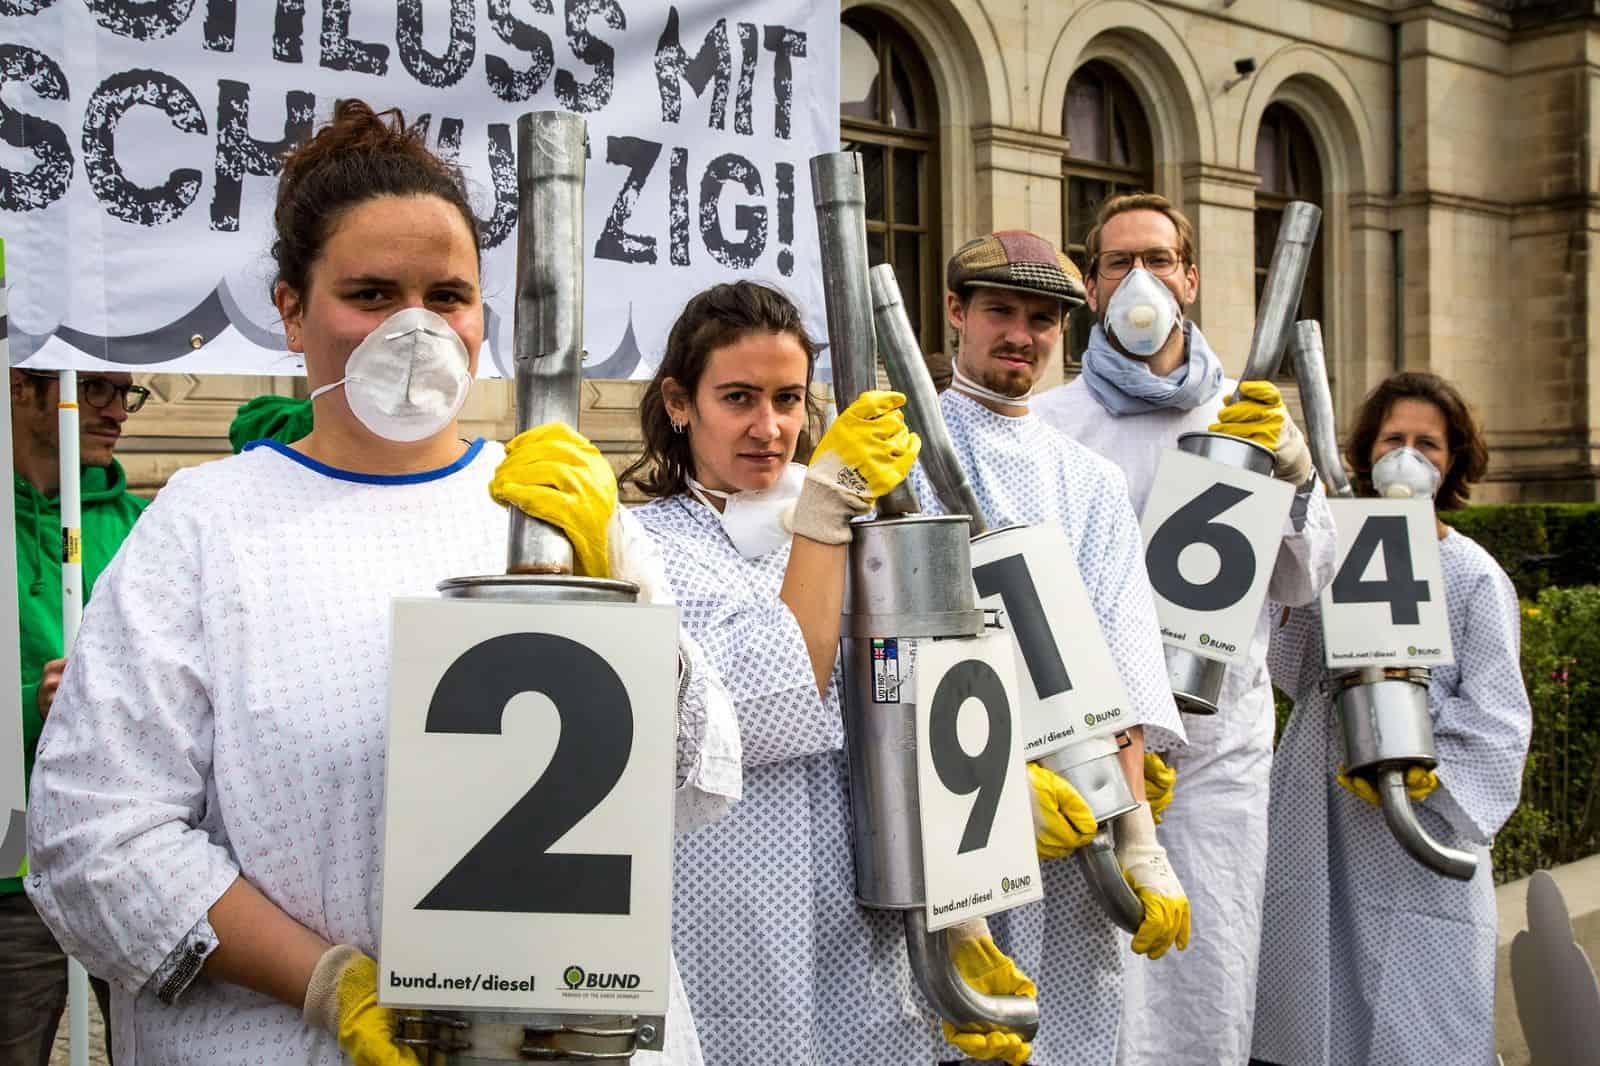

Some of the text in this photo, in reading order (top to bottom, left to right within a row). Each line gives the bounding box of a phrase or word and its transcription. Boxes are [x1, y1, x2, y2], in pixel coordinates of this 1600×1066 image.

[655, 6, 807, 140] MIT
[0, 43, 796, 278] SCHUZIG!
[1145, 482, 1256, 612] 6
[1332, 515, 1431, 625] 4
[973, 553, 1073, 700] 1
[1209, 639, 1237, 653] BUND
[929, 659, 1012, 855] 9
[1095, 707, 1121, 724] BUND
[413, 632, 634, 916] 2
[932, 888, 993, 916] bund.net/diesel
[1010, 875, 1031, 891] BUND
[390, 970, 535, 992] bund.net/diesel
[586, 972, 641, 989] BUND
